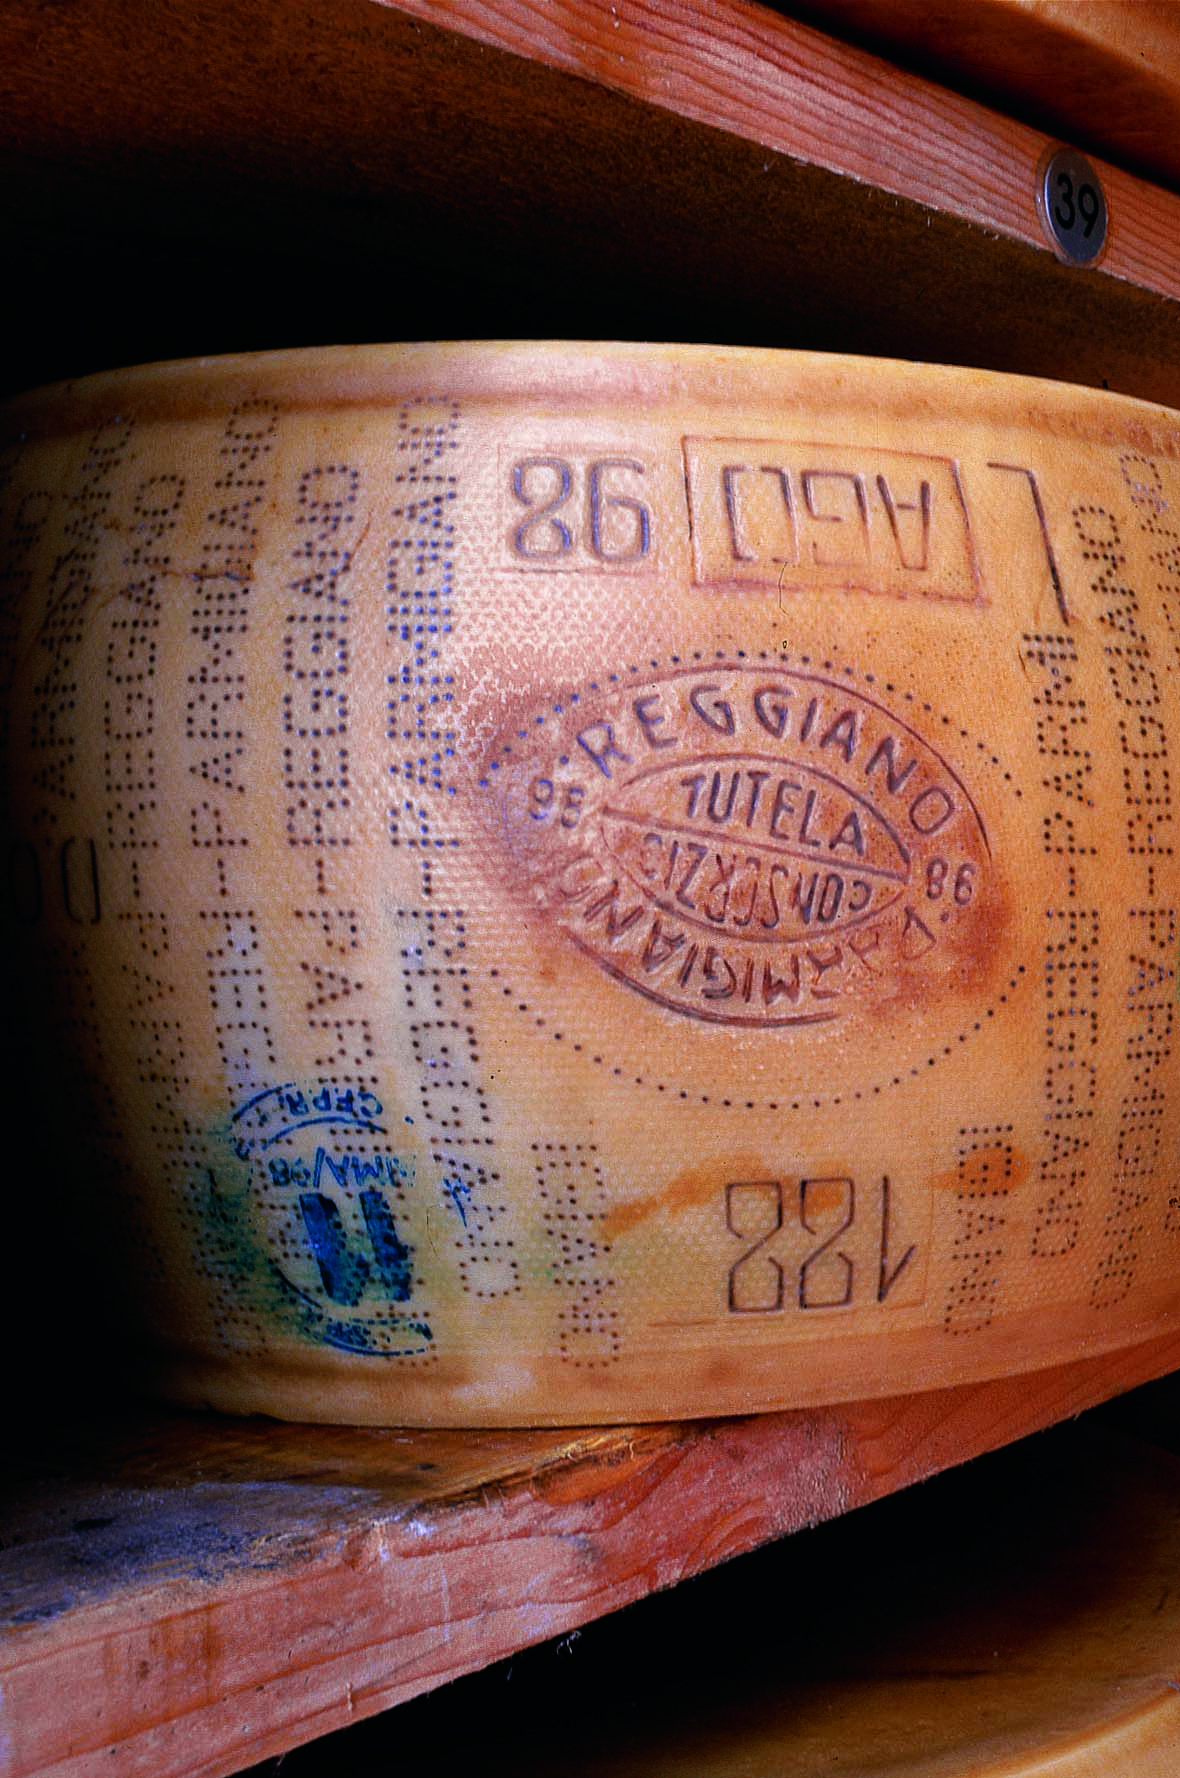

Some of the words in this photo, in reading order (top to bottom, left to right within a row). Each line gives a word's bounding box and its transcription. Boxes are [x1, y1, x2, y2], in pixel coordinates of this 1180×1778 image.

[1054, 172, 1100, 238] 39
[105, 475, 184, 848] REGGIANO
[284, 465, 357, 848] REGGIANO
[386, 396, 459, 848] PARMIGIANO
[577, 684, 956, 837] REGGIANO
[1072, 505, 1173, 855] REGGIANO
[681, 772, 867, 857] TUTELA
[397, 910, 519, 1297] REGGIANO
[1030, 910, 1101, 1260] REGGIANO
[1089, 909, 1176, 1311] PARMIGIANO
